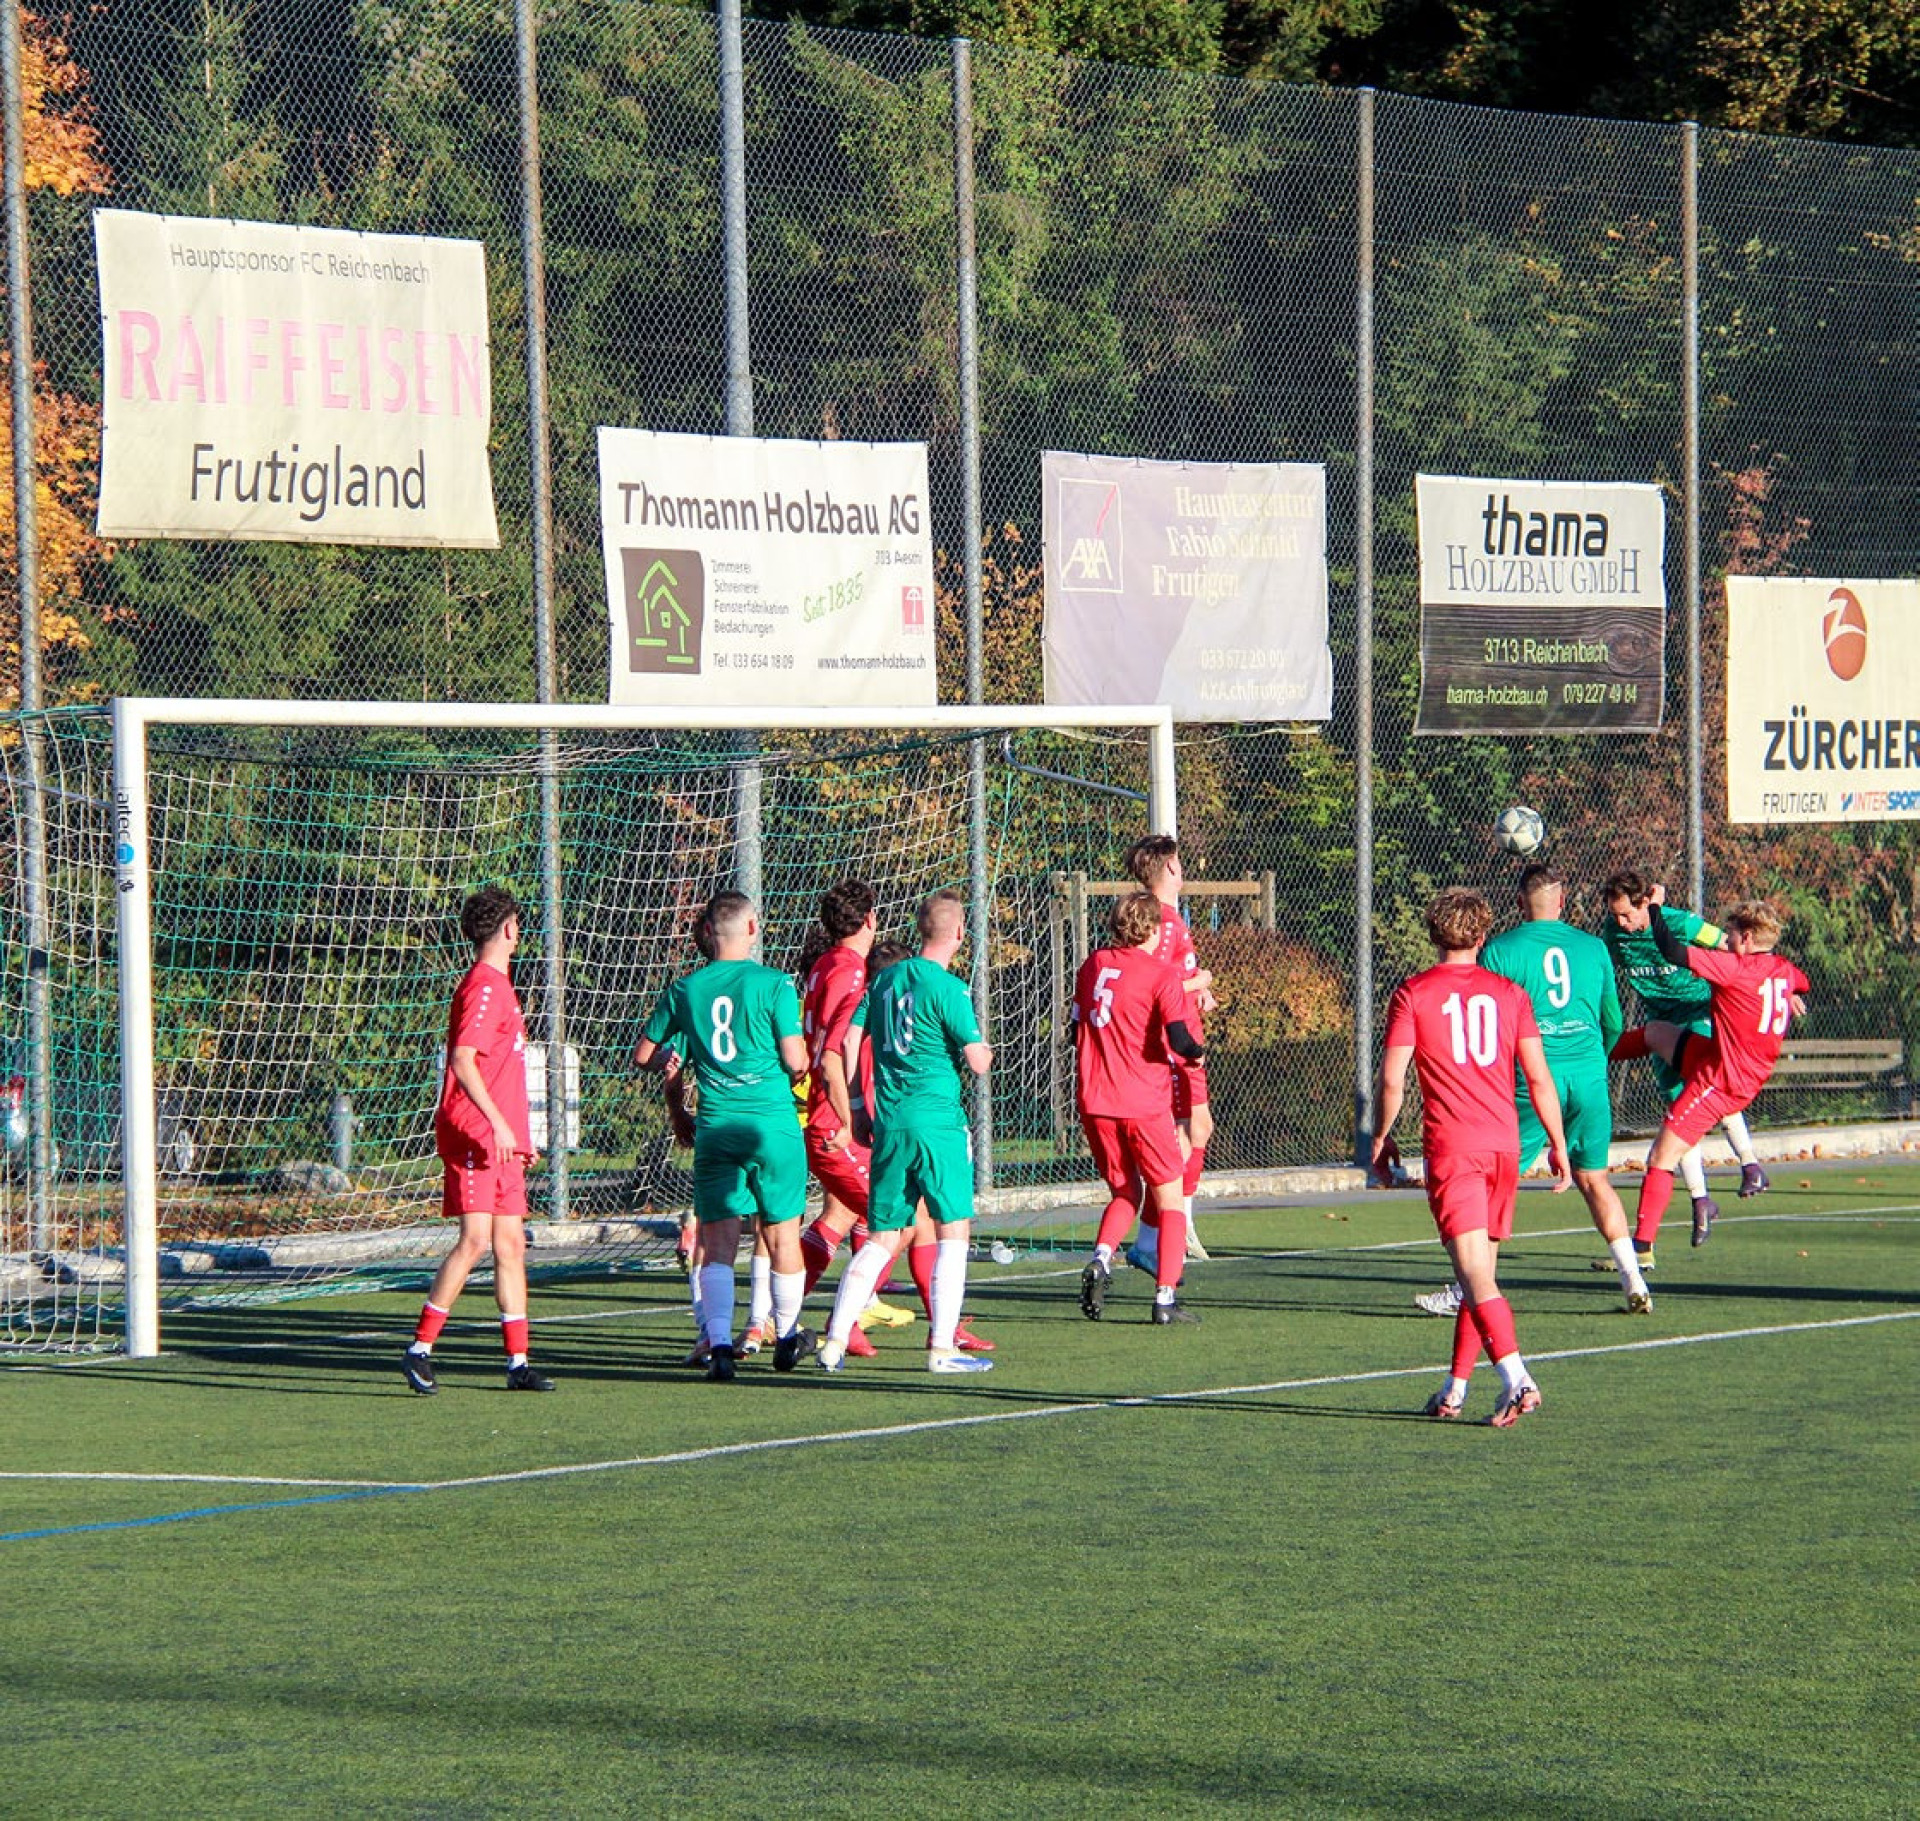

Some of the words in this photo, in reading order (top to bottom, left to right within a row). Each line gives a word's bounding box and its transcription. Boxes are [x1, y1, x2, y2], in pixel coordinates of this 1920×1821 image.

[169, 244, 295, 274] Hauptsponsor
[301, 252, 325, 276] FC
[328, 254, 430, 285] Reichenbach
[118, 310, 484, 419] RAIFFEISEN
[190, 442, 427, 522] Frutigland
[618, 480, 759, 531] Thomann
[764, 489, 880, 535] Holzbau
[888, 494, 920, 535] AG
[1165, 525, 1224, 559] Fabio
[1483, 493, 1608, 557] thama
[1061, 538, 1113, 581] AXA
[1152, 564, 1239, 606] Frutigen
[828, 570, 864, 613] 1835
[714, 619, 775, 638] Bedachungen
[1484, 637, 1519, 663] 3713
[1523, 638, 1608, 663] Reichenbach
[1584, 683, 1607, 704] 227
[1763, 704, 1920, 771] ZÜRCHER
[1763, 793, 1828, 813] FRUTIGEN
[1089, 967, 1122, 1028] 5
[1542, 946, 1572, 1009] 9
[710, 995, 737, 1063] 8
[1441, 992, 1498, 1067] 10
[1757, 978, 1790, 1036] 15
